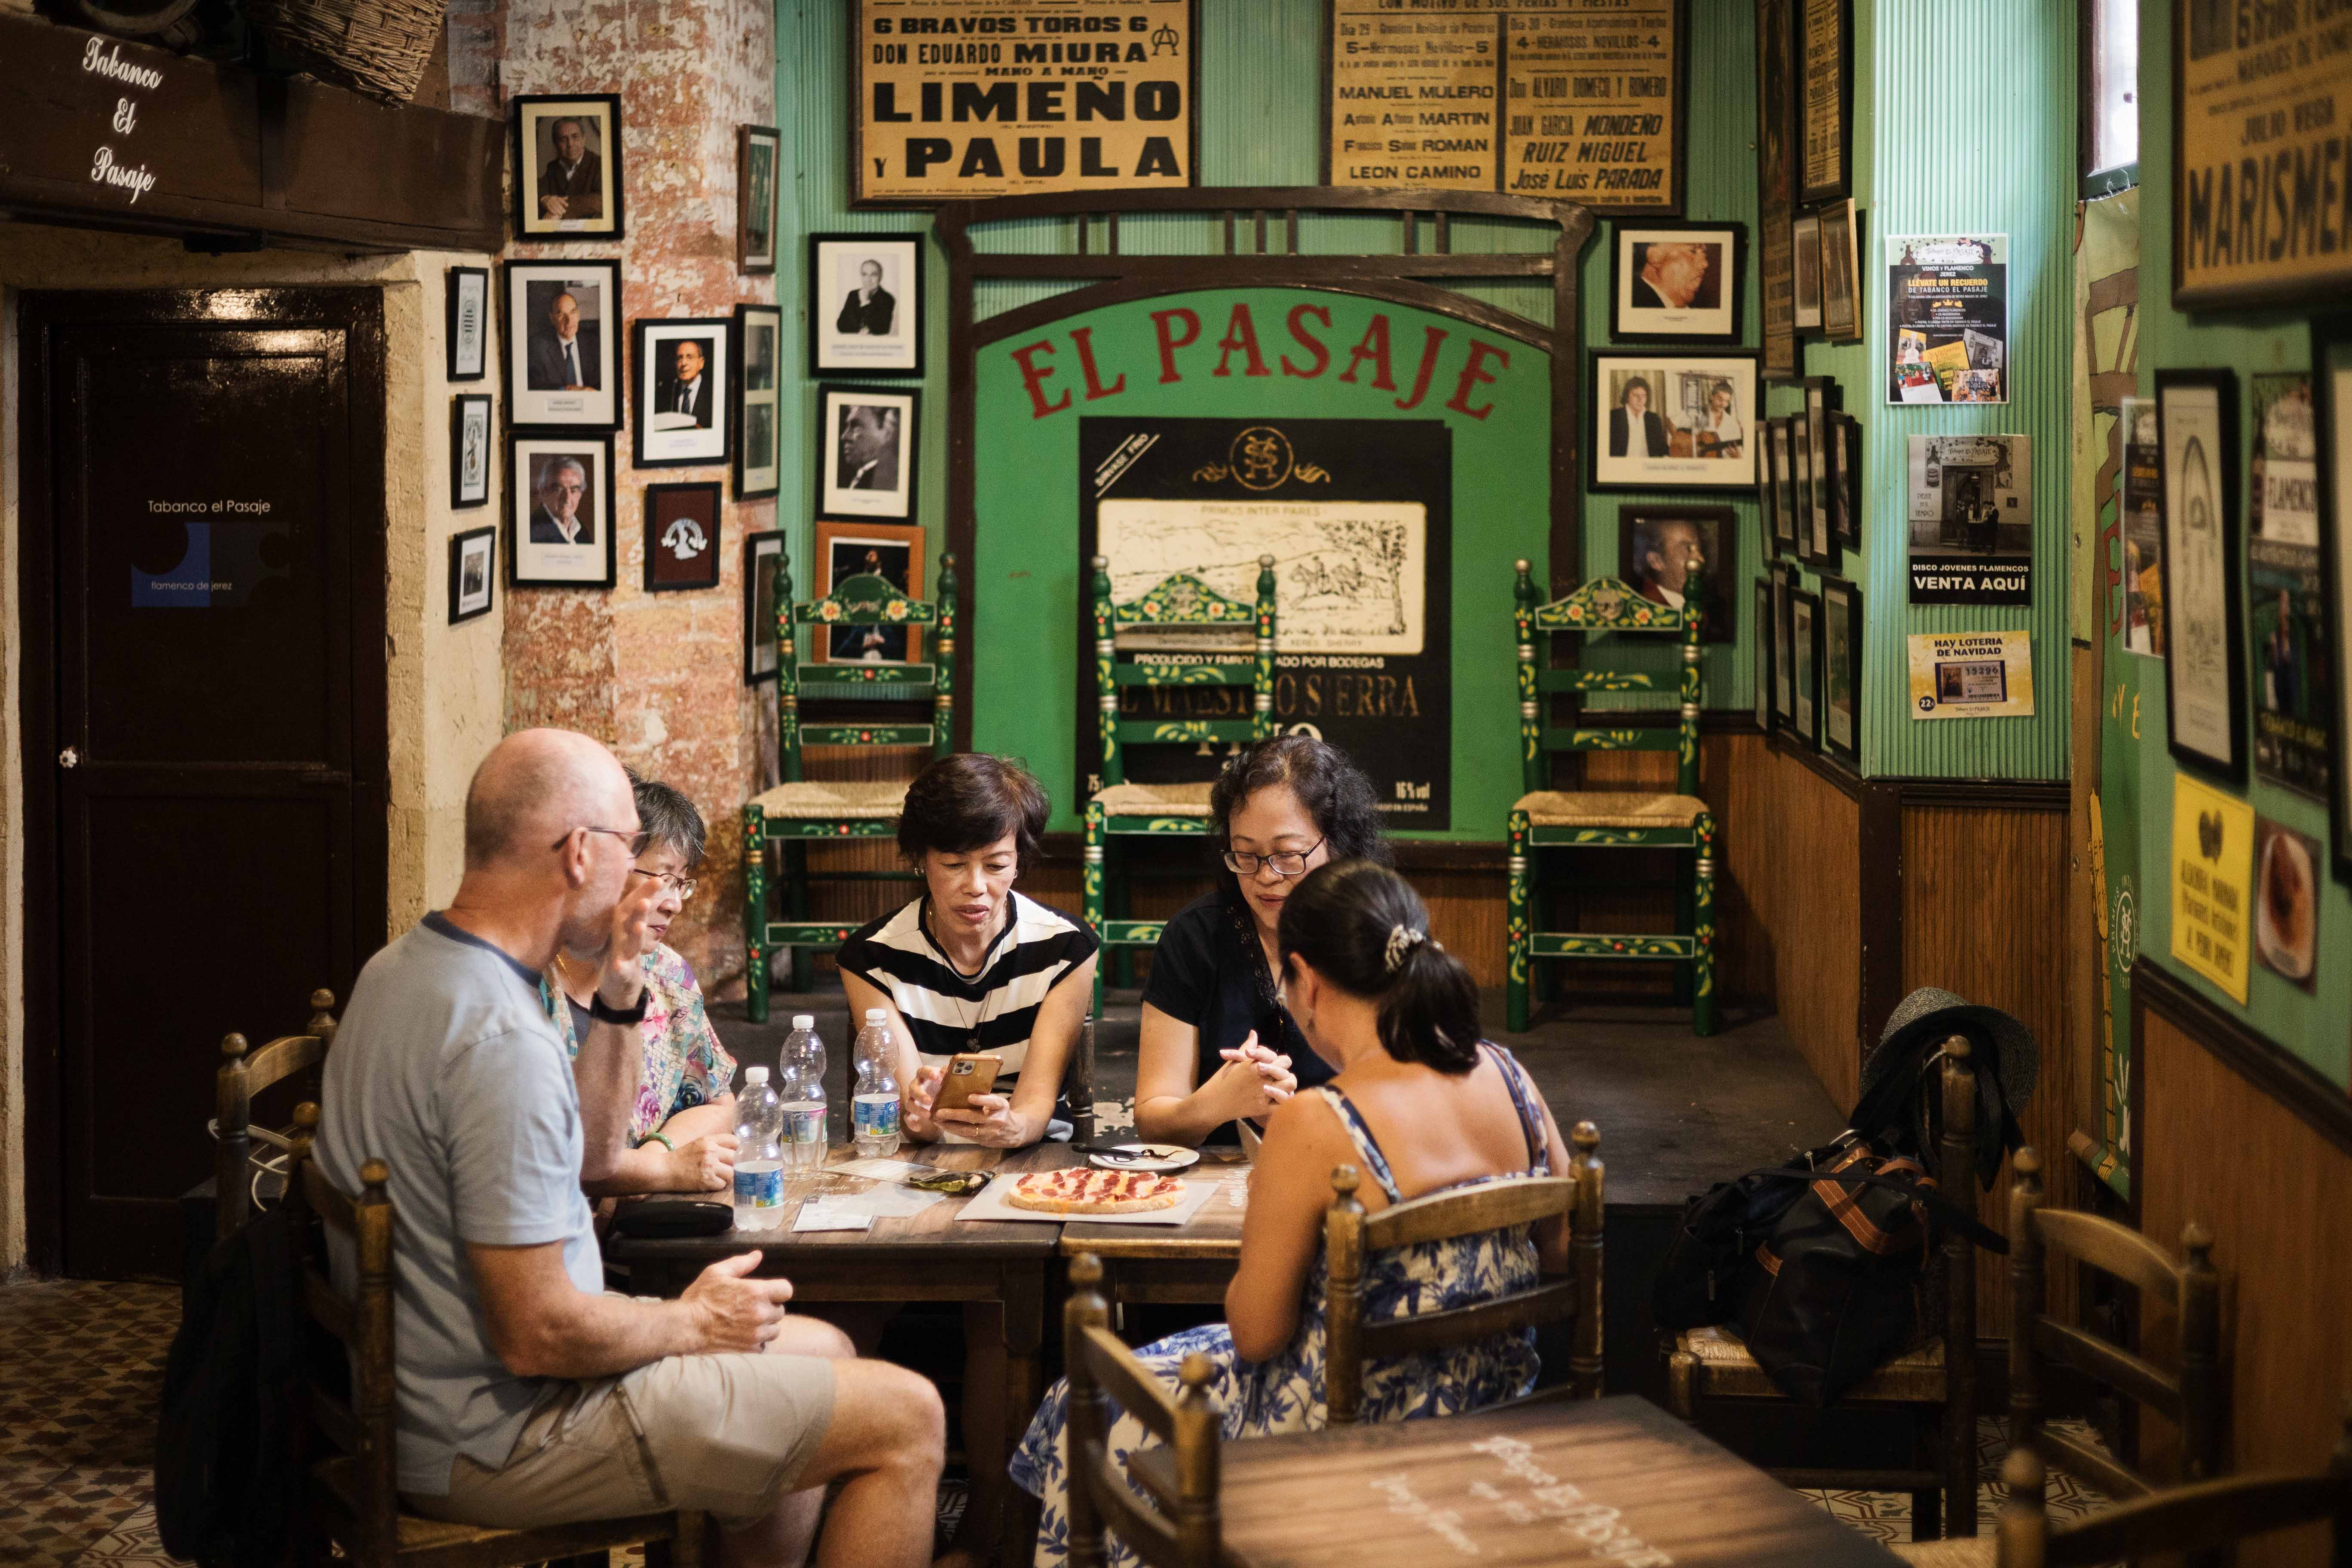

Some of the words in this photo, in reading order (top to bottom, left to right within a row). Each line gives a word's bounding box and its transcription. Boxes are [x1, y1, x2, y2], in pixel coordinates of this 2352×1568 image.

[874, 18, 893, 34] 6
[900, 17, 1017, 34] BRAVOS
[1024, 16, 1121, 33] TOROS
[1129, 16, 1148, 32] 6
[873, 43, 907, 64] DON
[919, 43, 1001, 64] EDUARDO
[1014, 43, 1147, 63] MIURA
[82, 36, 163, 89] Tabanco
[986, 67, 1033, 76] MANO
[873, 77, 1182, 122] LIMEÑO
[1340, 86, 1413, 98] MANUEL
[1419, 86, 1494, 98] MULERO
[113, 98, 136, 135] El
[1419, 113, 1490, 125] MARTIN
[1422, 139, 1488, 151] ROMAN
[1523, 142, 1570, 163] RUIZ
[1577, 141, 1648, 163] MIGUEL
[874, 158, 887, 178] Y
[906, 137, 1182, 178] PAULA
[91, 146, 157, 204] Pasaje
[1350, 166, 1399, 179] LEON
[1406, 165, 1481, 179] CAMINO
[1593, 168, 1664, 190] PARADA
[1011, 325, 1125, 420] EL
[1150, 303, 1510, 420] PASAJE
[148, 500, 207, 513] Tabanco
[211, 499, 223, 513] el
[227, 499, 271, 515] Pasaje
[1201, 505, 1243, 516] PRIMUS
[1246, 505, 1280, 515] INTER
[1283, 506, 1321, 516] PARES
[151, 581, 194, 591] flamenco
[197, 581, 209, 591] de
[211, 582, 233, 592] jerez
[1914, 576, 1976, 591] VENTA
[1981, 575, 2025, 591] AQUÍ
[1959, 637, 2003, 647] LOTERIA
[1954, 647, 2002, 656] NAVIDAD
[1134, 654, 1203, 666] PRODUCIDO
[1204, 654, 1213, 666] Y
[1302, 656, 1326, 668] POR
[1328, 655, 1385, 669] BODEGAS
